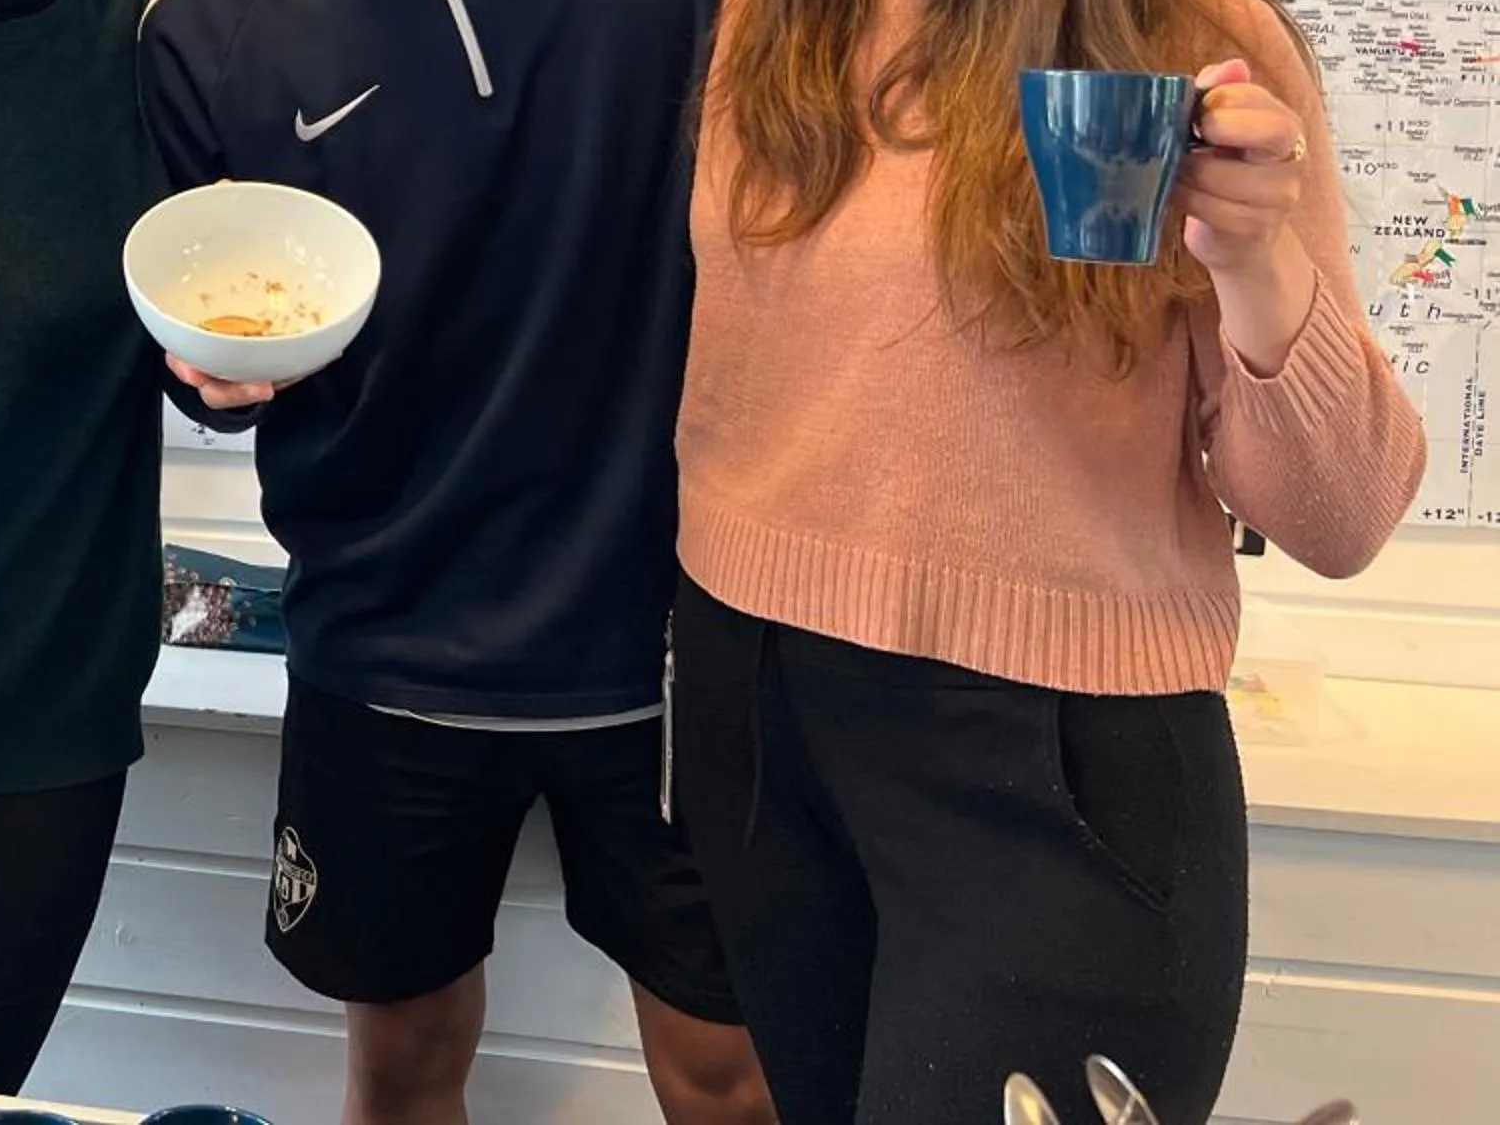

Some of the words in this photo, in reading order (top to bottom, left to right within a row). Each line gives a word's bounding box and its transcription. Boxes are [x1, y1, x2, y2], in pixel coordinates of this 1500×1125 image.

[1374, 227, 1446, 238] ZEALAND
[1392, 215, 1429, 225] NEW
[1476, 390, 1486, 420] LINE
[1461, 377, 1474, 474] INTERNATIONAL
[1474, 425, 1483, 457] DATE
